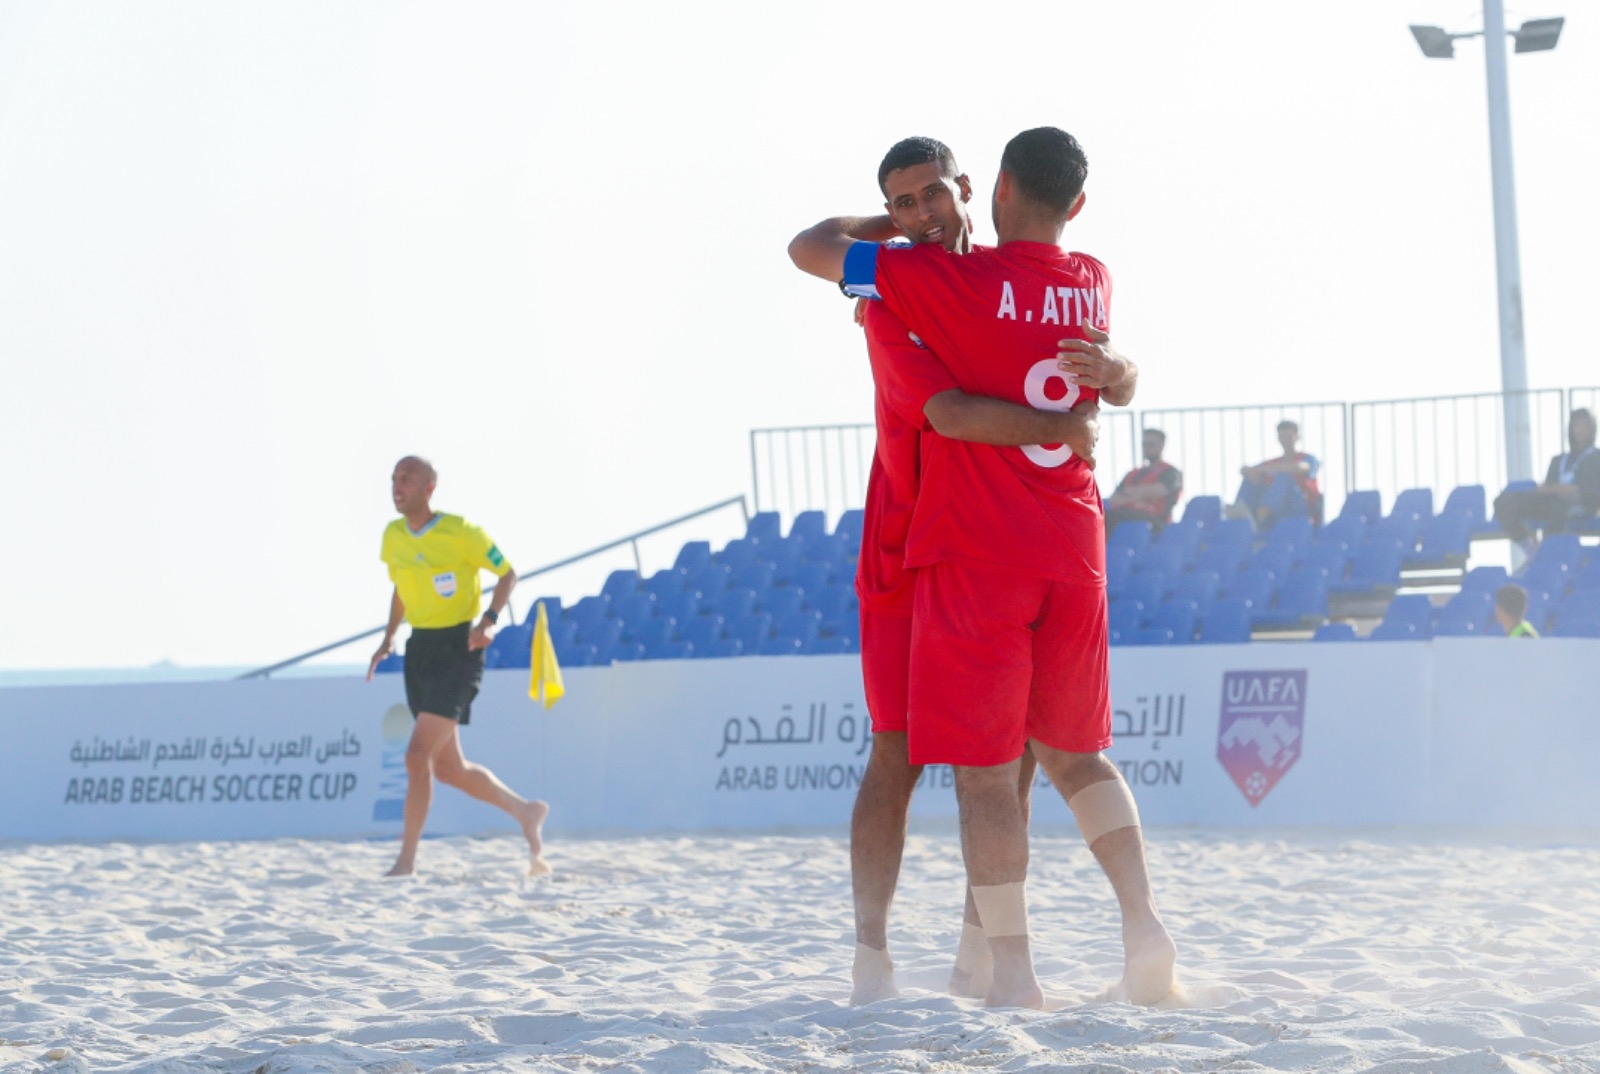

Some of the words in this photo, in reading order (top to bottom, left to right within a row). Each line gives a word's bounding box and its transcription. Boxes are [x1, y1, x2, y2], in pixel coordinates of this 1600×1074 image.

[1041, 286, 1108, 327] ATIYA
[1227, 678, 1300, 703] UAFA
[315, 727, 362, 764] كأس
[716, 702, 827, 758] القدم
[153, 736, 207, 770] القدم
[210, 736, 255, 767] لكرة
[258, 736, 313, 765] العرب
[64, 776, 125, 804] ARAB
[129, 775, 207, 803] BEACH
[212, 773, 303, 801] SOCCER
[308, 771, 358, 800] CUP
[715, 765, 778, 791] ARAB
